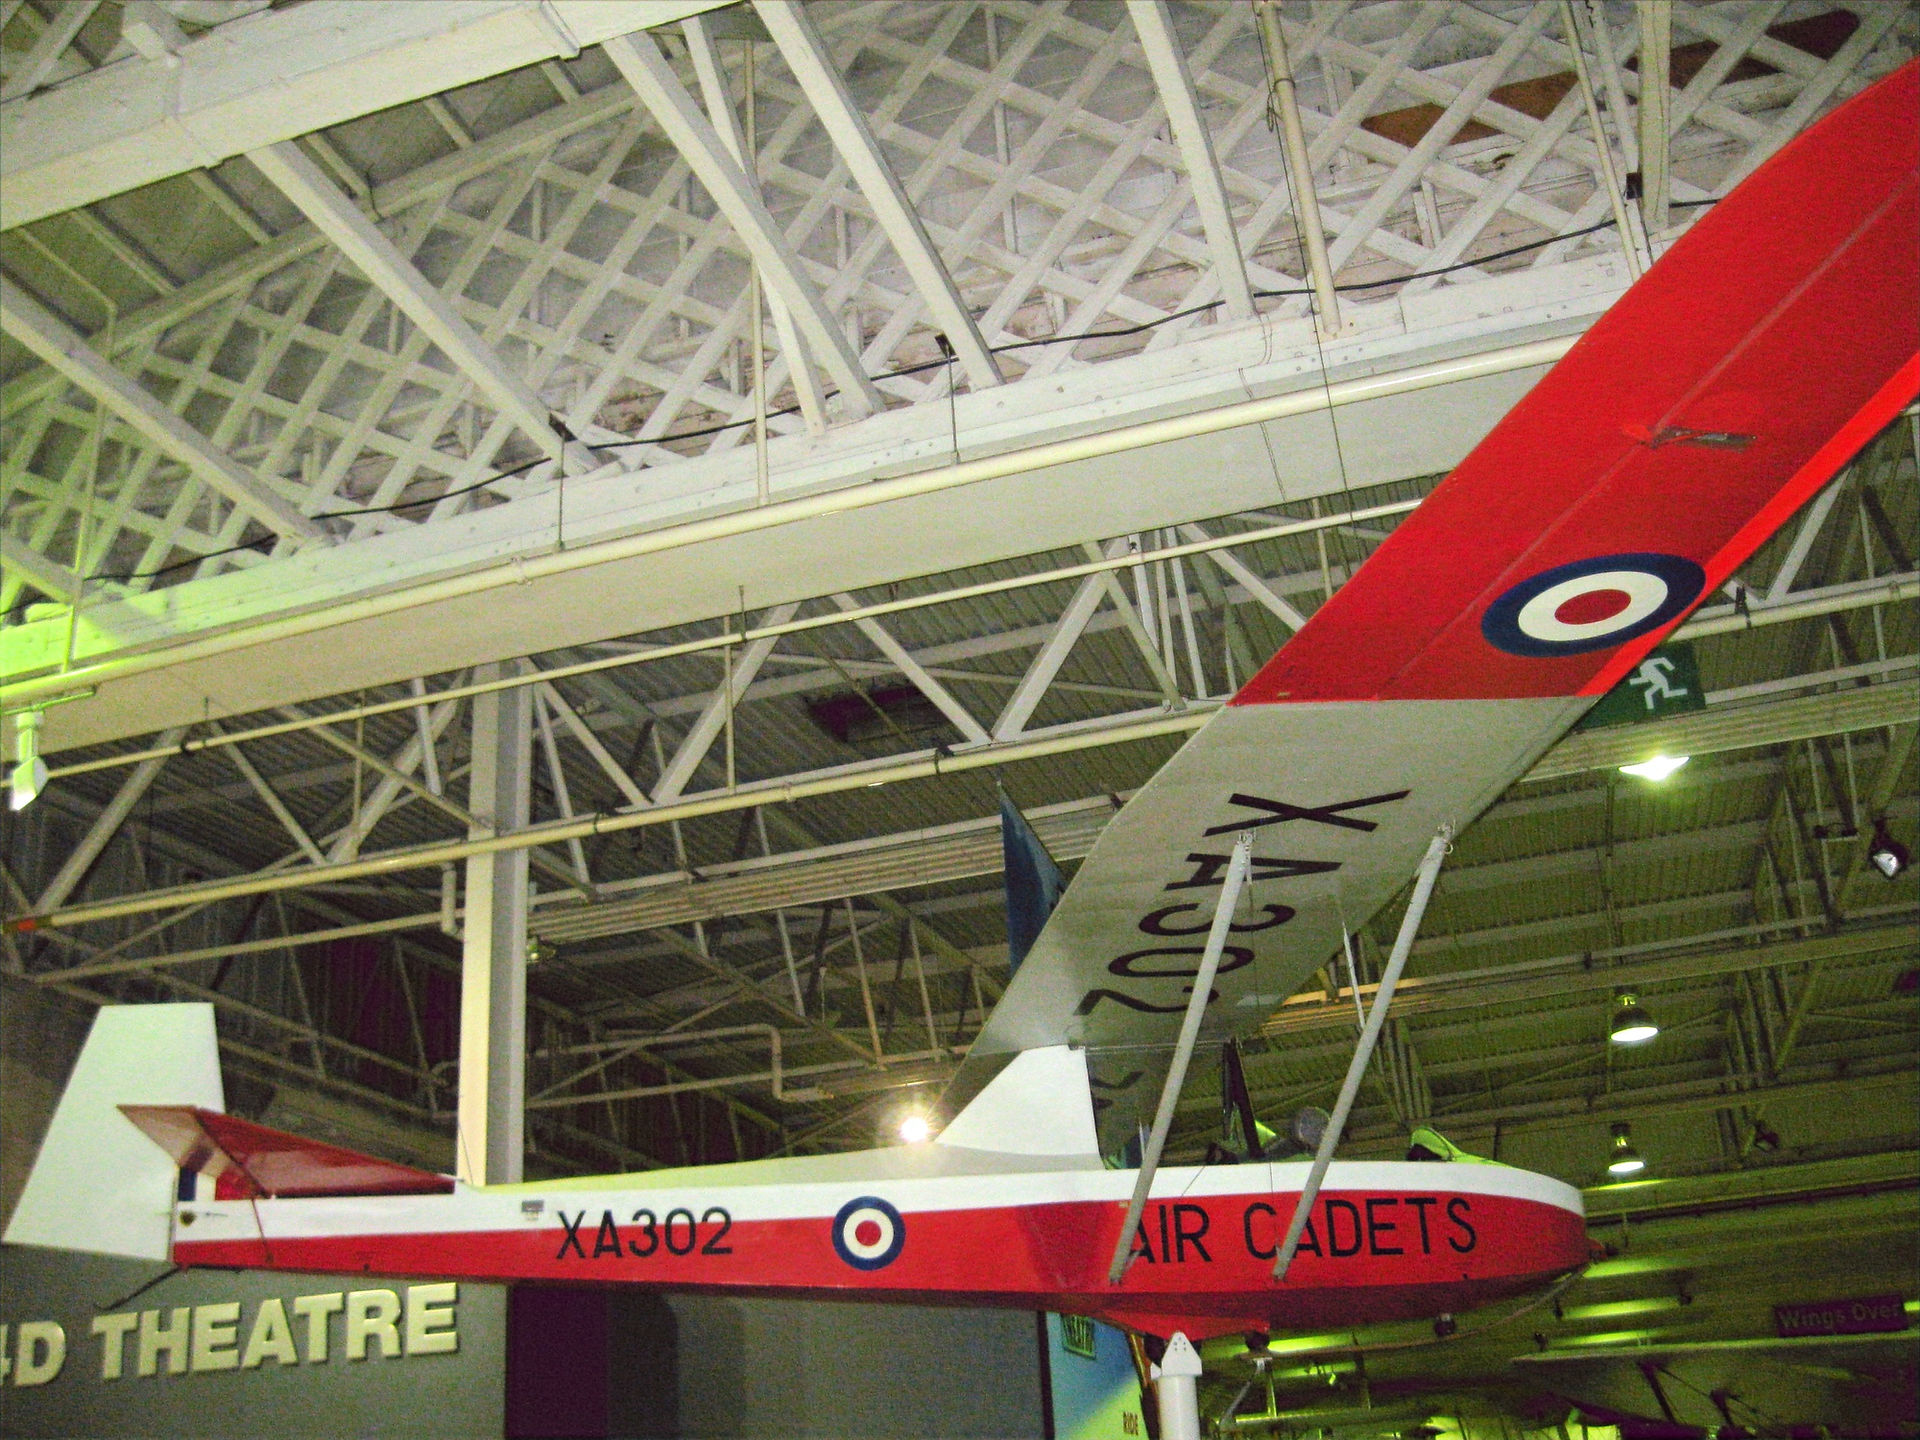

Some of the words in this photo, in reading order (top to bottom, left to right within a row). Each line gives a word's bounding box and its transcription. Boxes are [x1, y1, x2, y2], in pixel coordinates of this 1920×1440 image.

[1072, 789, 1412, 1016] XA302
[556, 1207, 733, 1259] XA302
[1127, 1203, 1213, 1264] AIR
[1243, 1197, 1478, 1261] CADETS
[92, 1282, 459, 1380] THEATRE
[1779, 1309, 1847, 1331] Wings
[1853, 1303, 1900, 1322] Over
